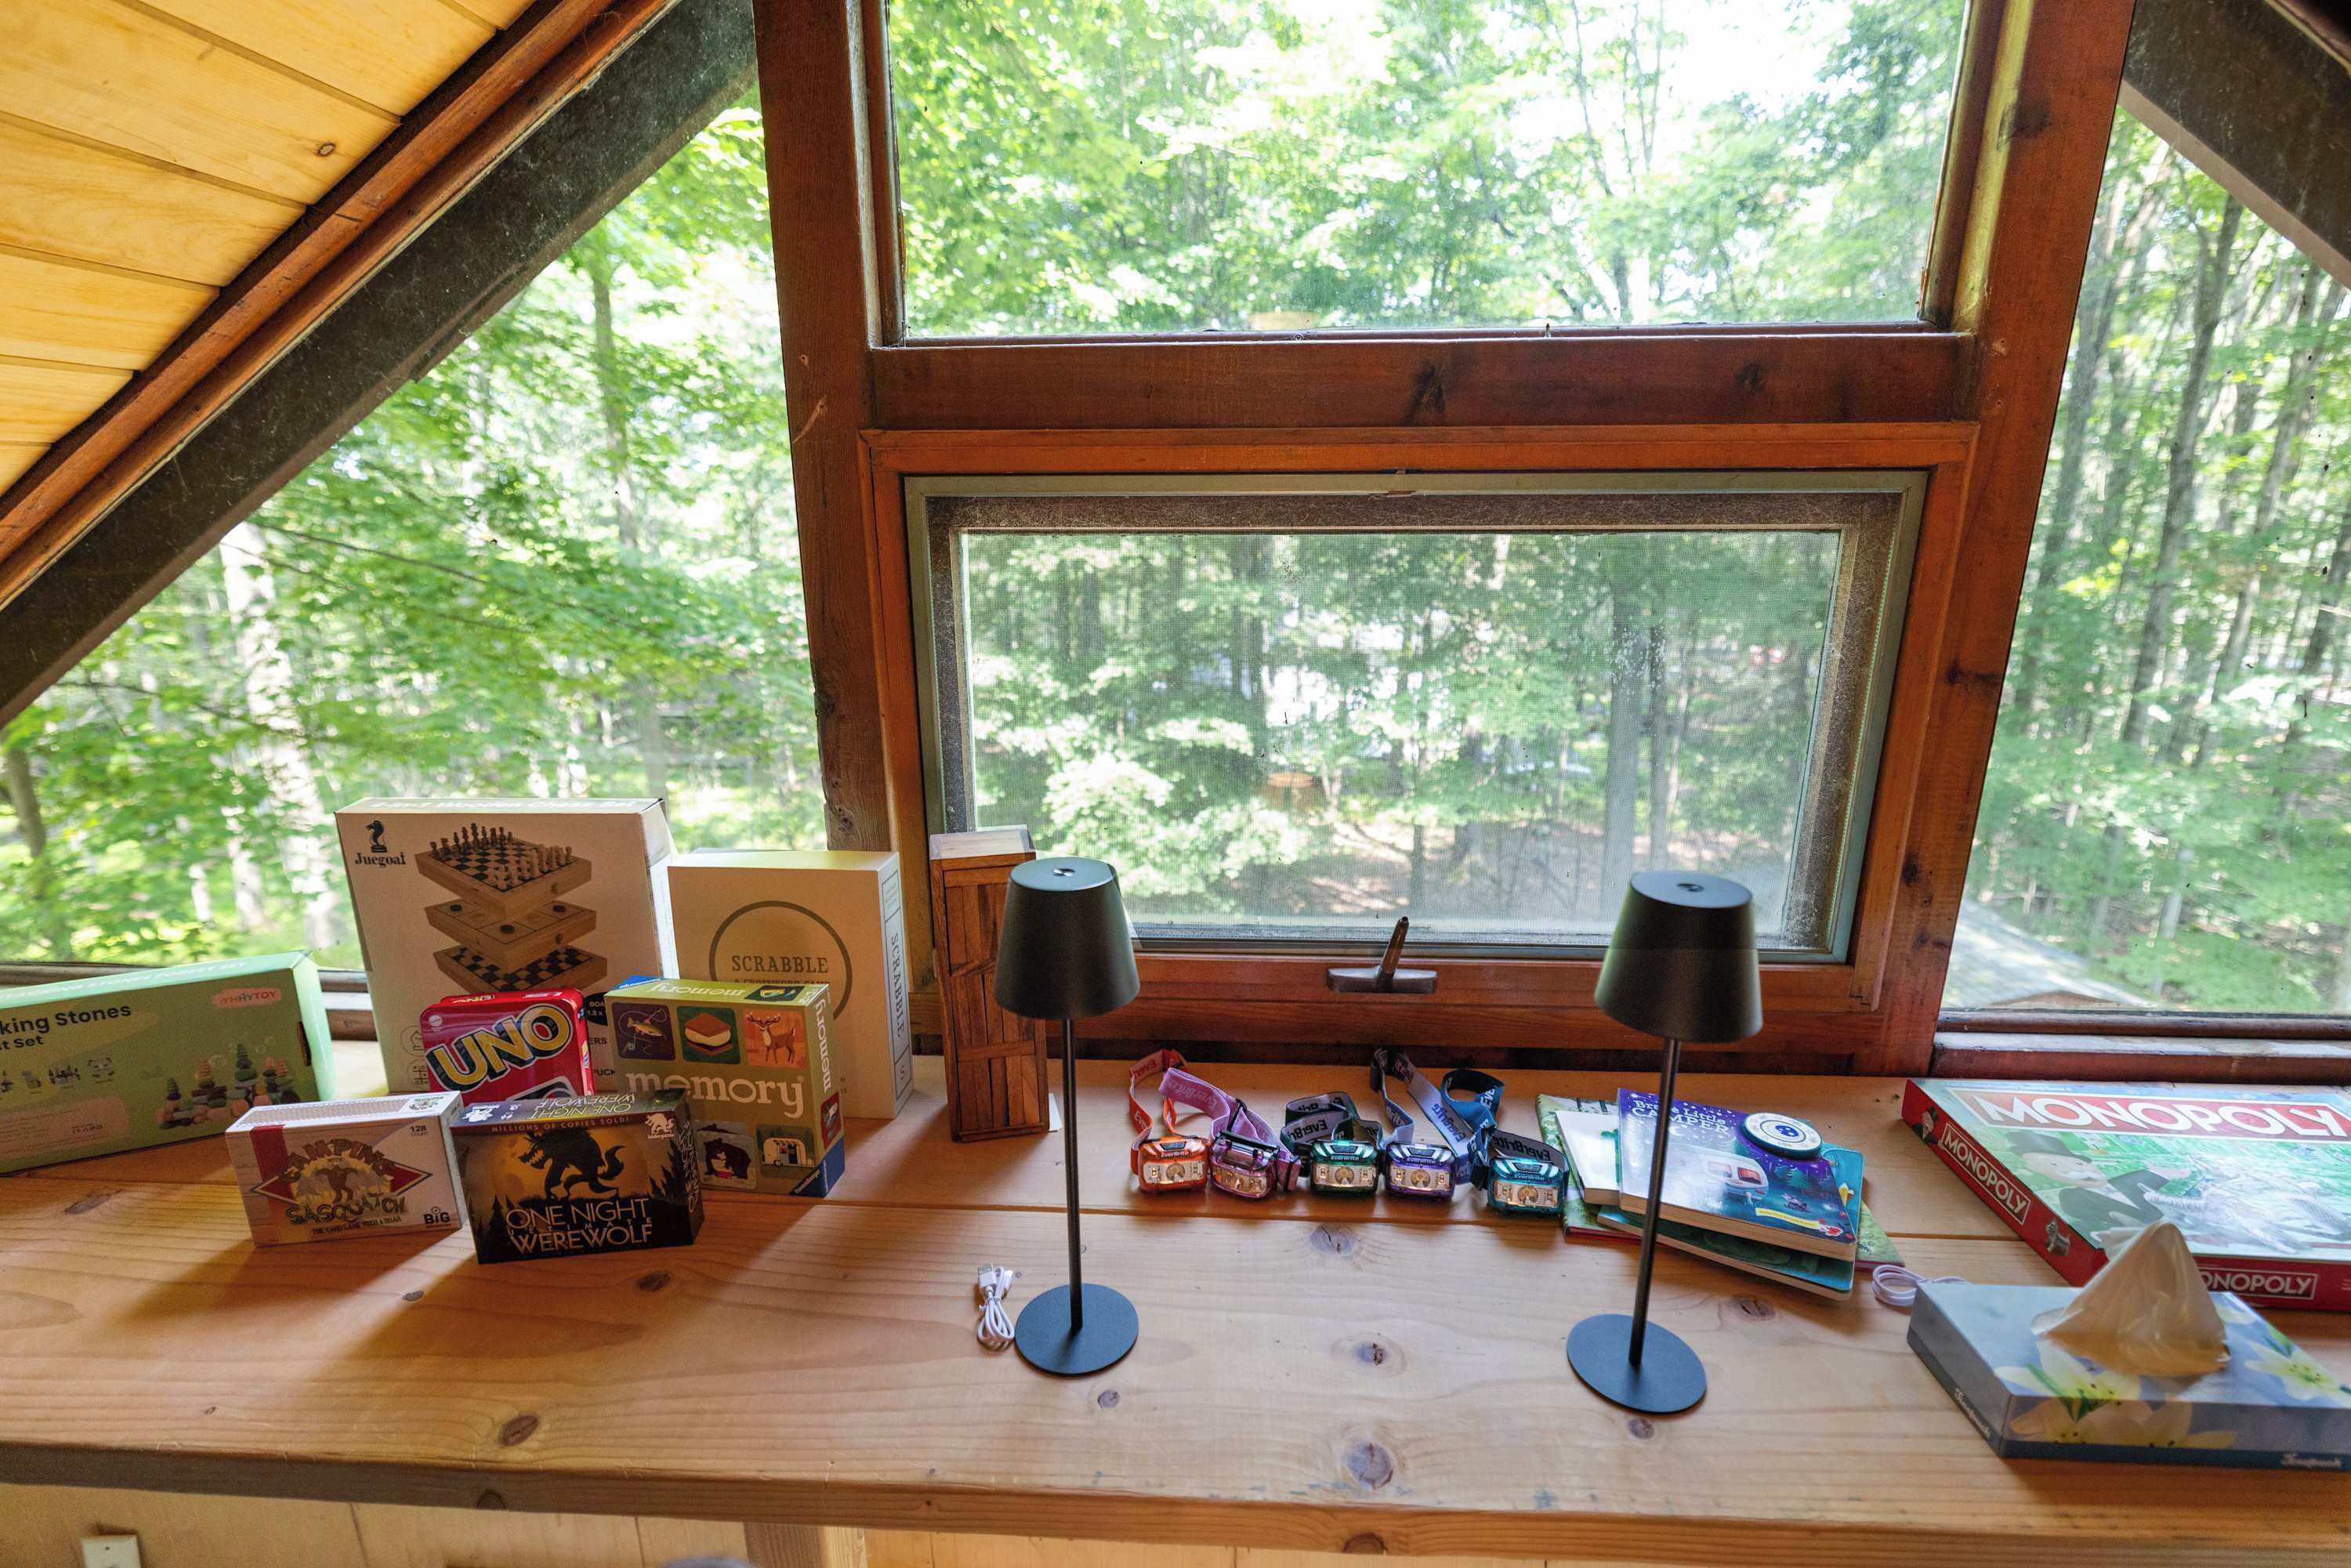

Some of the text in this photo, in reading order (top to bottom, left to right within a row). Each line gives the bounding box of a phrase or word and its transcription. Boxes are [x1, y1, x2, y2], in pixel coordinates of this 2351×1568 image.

[731, 955, 828, 973] SCRABBLE
[650, 983, 745, 997] memory
[890, 932, 905, 1037] SCRABBLE
[55, 1003, 132, 1027] Stones
[13, 1035, 44, 1048] Set
[426, 1003, 573, 1093] UNO
[815, 998, 832, 1092] memory
[625, 1073, 803, 1118] memory
[491, 1124, 541, 1133] MILLIONS
[544, 1121, 558, 1130] OF
[561, 1119, 596, 1128] COPIES
[526, 1103, 632, 1120] ONE NIGHT
[1683, 1108, 1726, 1124] Little
[1972, 1096, 2349, 1137] MONOPOLY
[1944, 1130, 2027, 1214] MONOPOLY
[506, 1198, 650, 1229] ONE NIGHT
[509, 1223, 653, 1255] WEREWOLF
